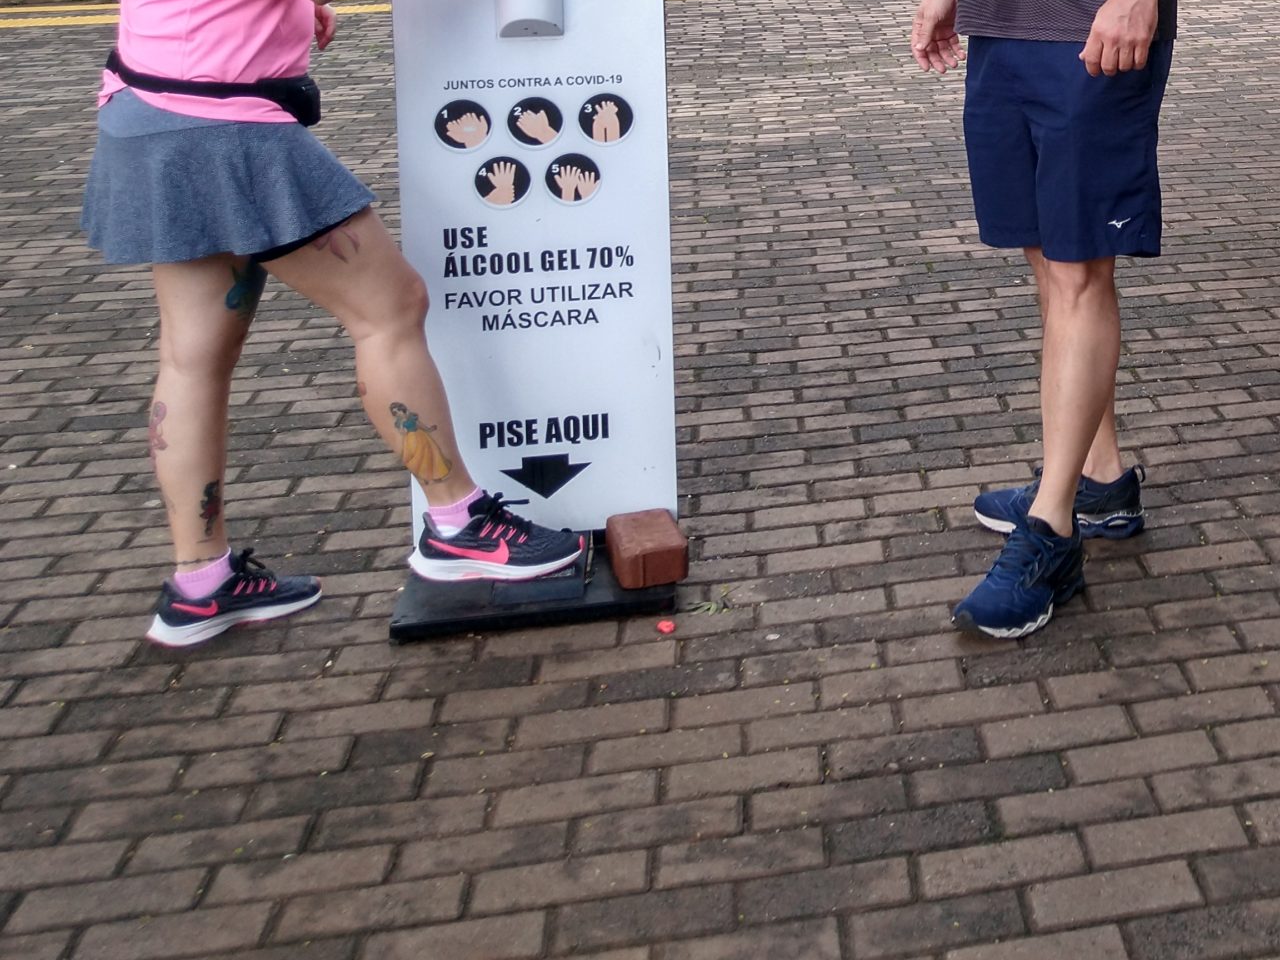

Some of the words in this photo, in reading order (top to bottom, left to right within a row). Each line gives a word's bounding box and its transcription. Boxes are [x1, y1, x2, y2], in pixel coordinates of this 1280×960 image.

[443, 80, 494, 90] JUNTOS
[498, 77, 551, 88] CONTRA
[554, 77, 563, 86] A
[566, 75, 623, 85] COVID-19
[441, 110, 448, 118] 1
[513, 107, 522, 116] 2
[584, 104, 592, 113] 3
[479, 168, 487, 176] 4
[552, 164, 559, 173] 5
[443, 226, 488, 250] USE
[443, 252, 534, 278] ÁLCOOL
[540, 249, 581, 272] GEL
[586, 245, 634, 268] 70%
[445, 289, 523, 309] FAVOR
[530, 282, 634, 304] UTILIZAR
[482, 308, 599, 331] MÁSCARA
[479, 418, 538, 449] PISE
[545, 413, 609, 444] AQUI
